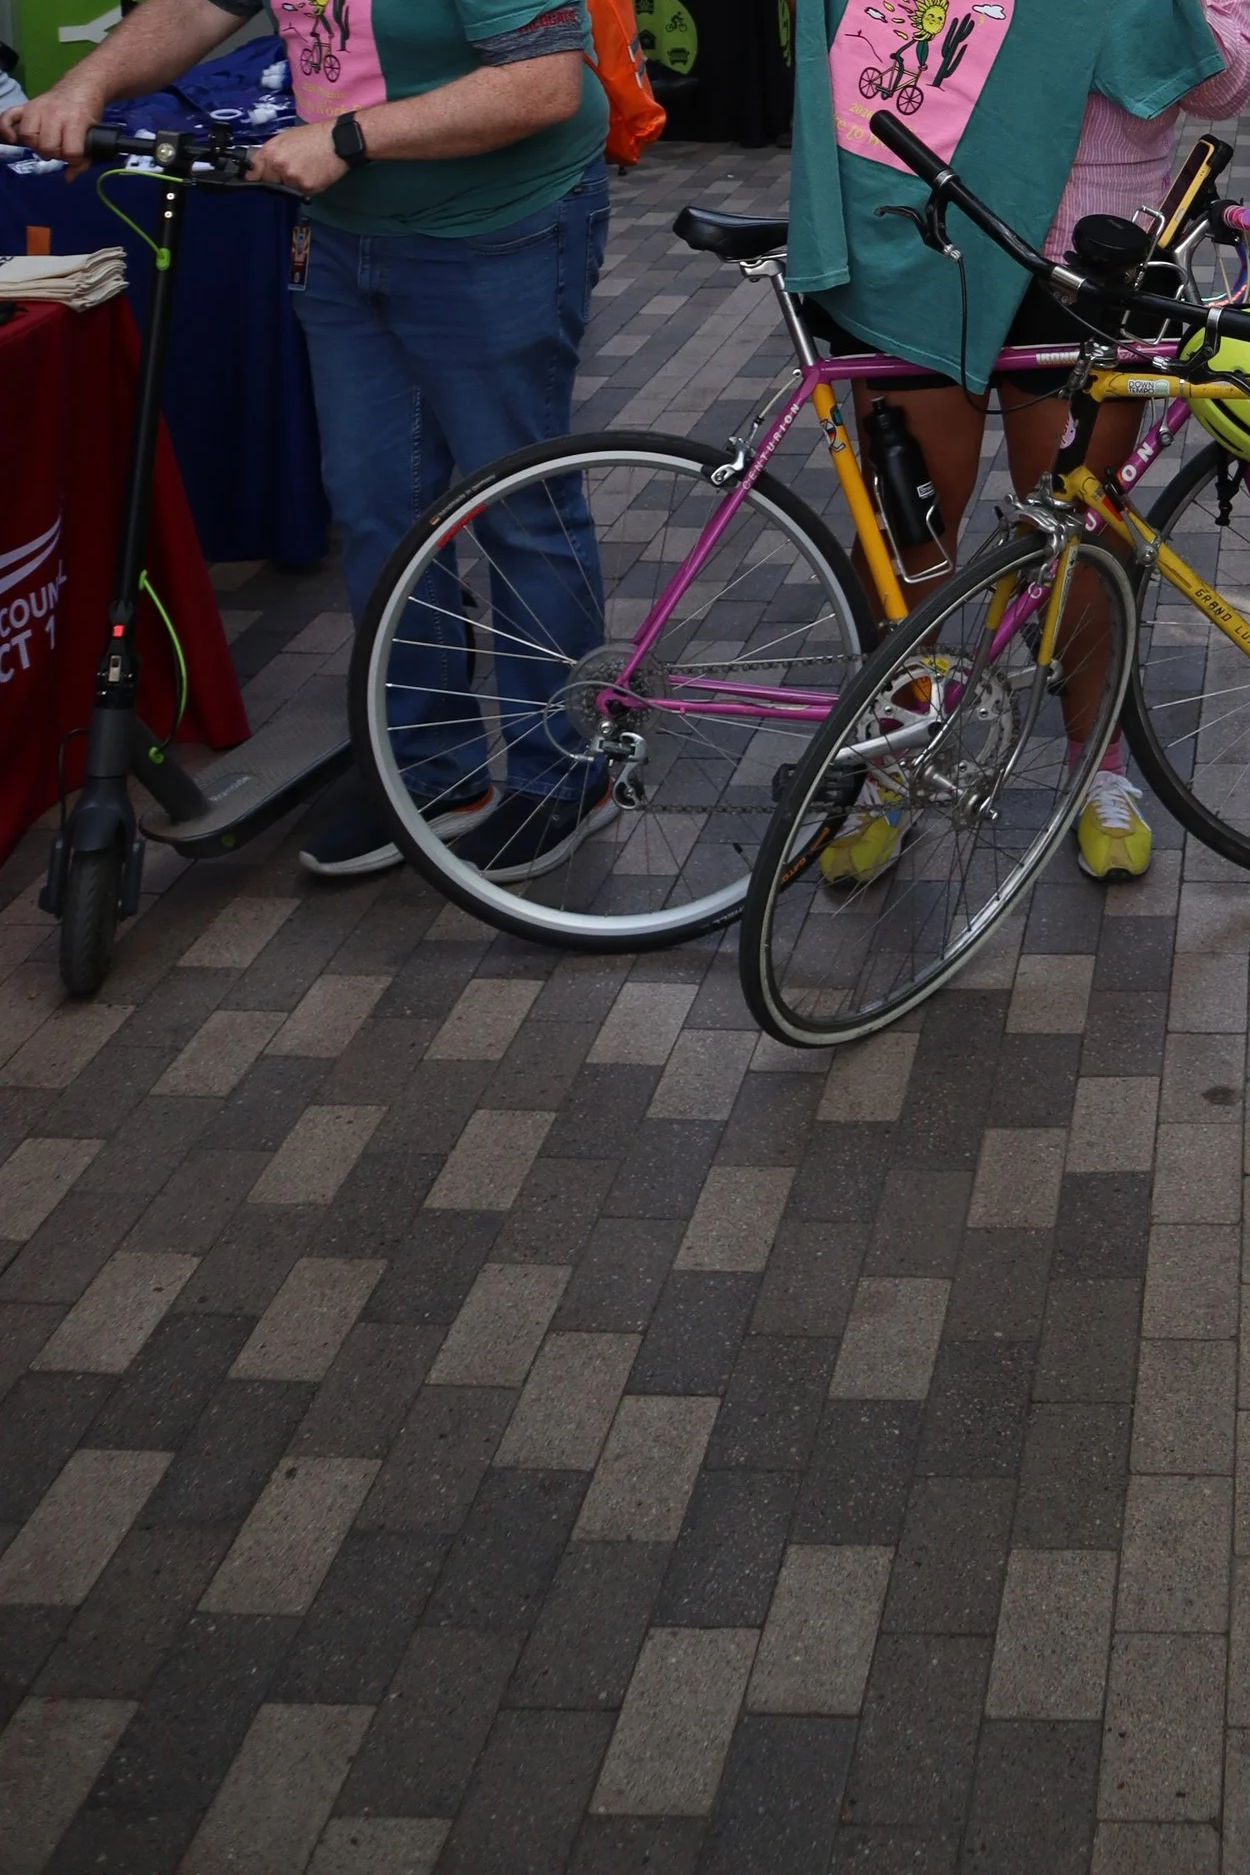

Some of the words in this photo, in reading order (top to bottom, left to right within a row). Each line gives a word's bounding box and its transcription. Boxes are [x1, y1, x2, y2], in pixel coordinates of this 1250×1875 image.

[1128, 380, 1155, 388] DOWN
[742, 402, 800, 490] CENTURION
[1195, 588, 1232, 622] GRAND
